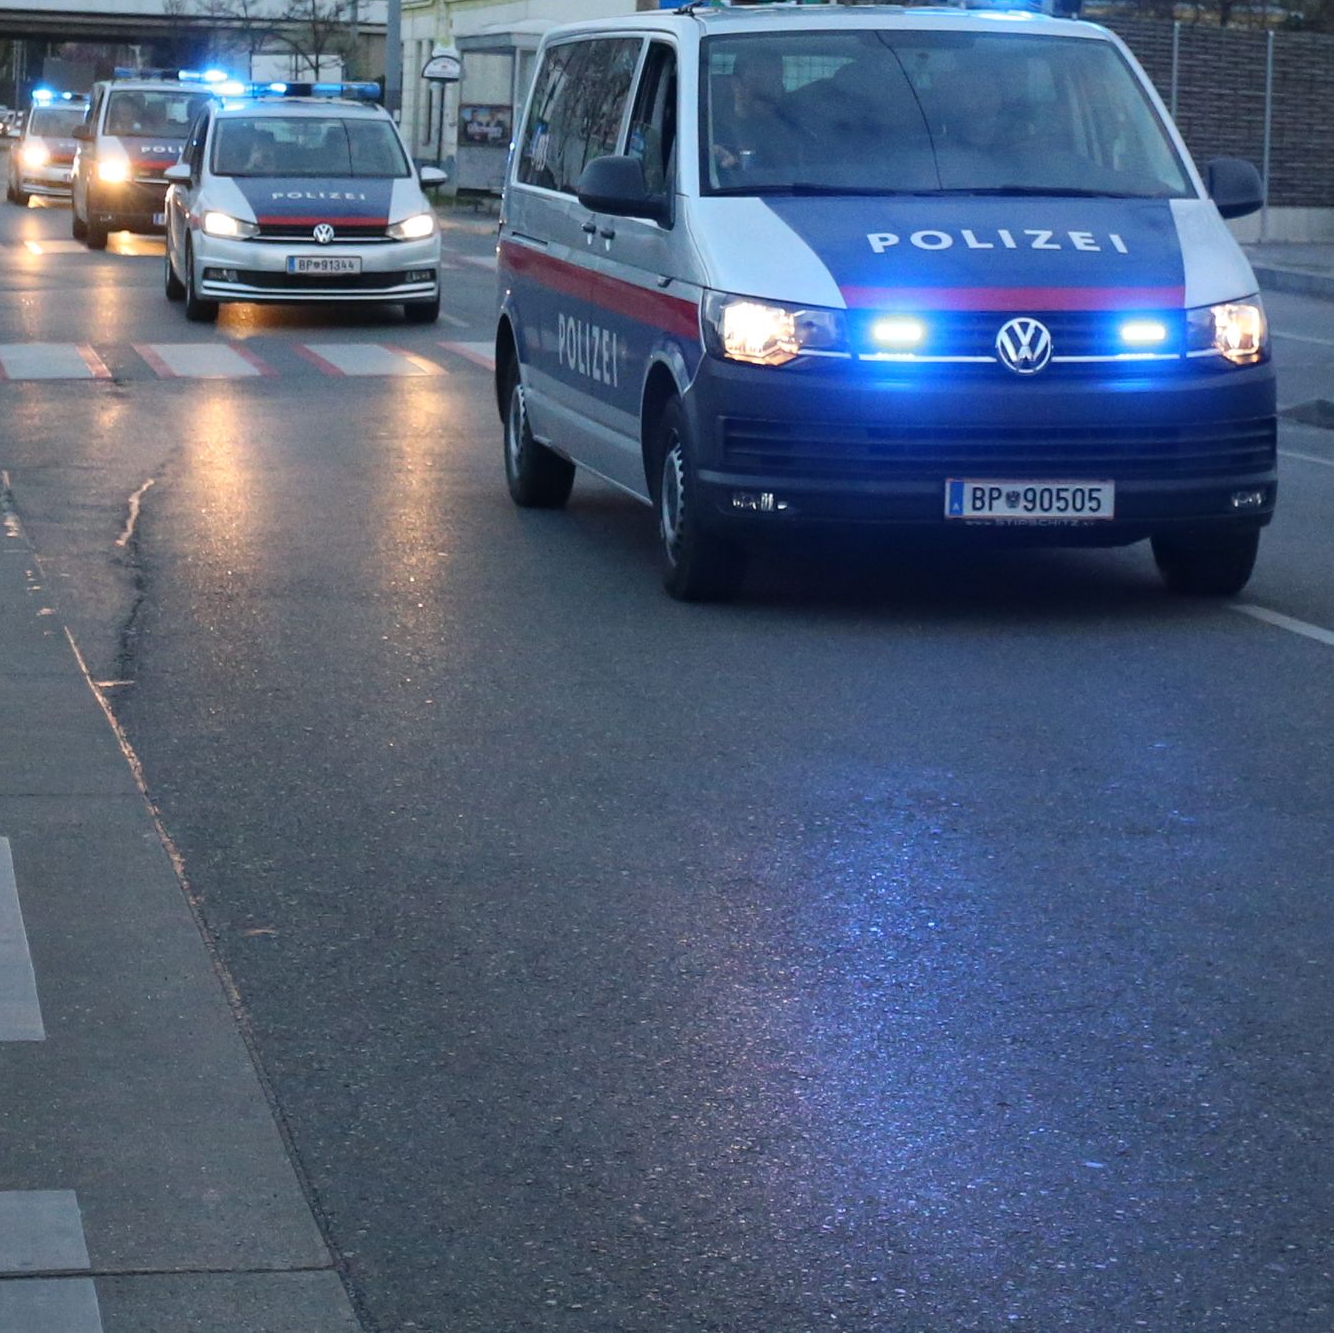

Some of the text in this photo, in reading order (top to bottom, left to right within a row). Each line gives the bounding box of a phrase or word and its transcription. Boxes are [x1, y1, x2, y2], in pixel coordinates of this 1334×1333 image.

[271, 192, 366, 201] POLIZEI
[867, 229, 1128, 254] POLIZEI
[558, 313, 618, 388] POLIZEI
